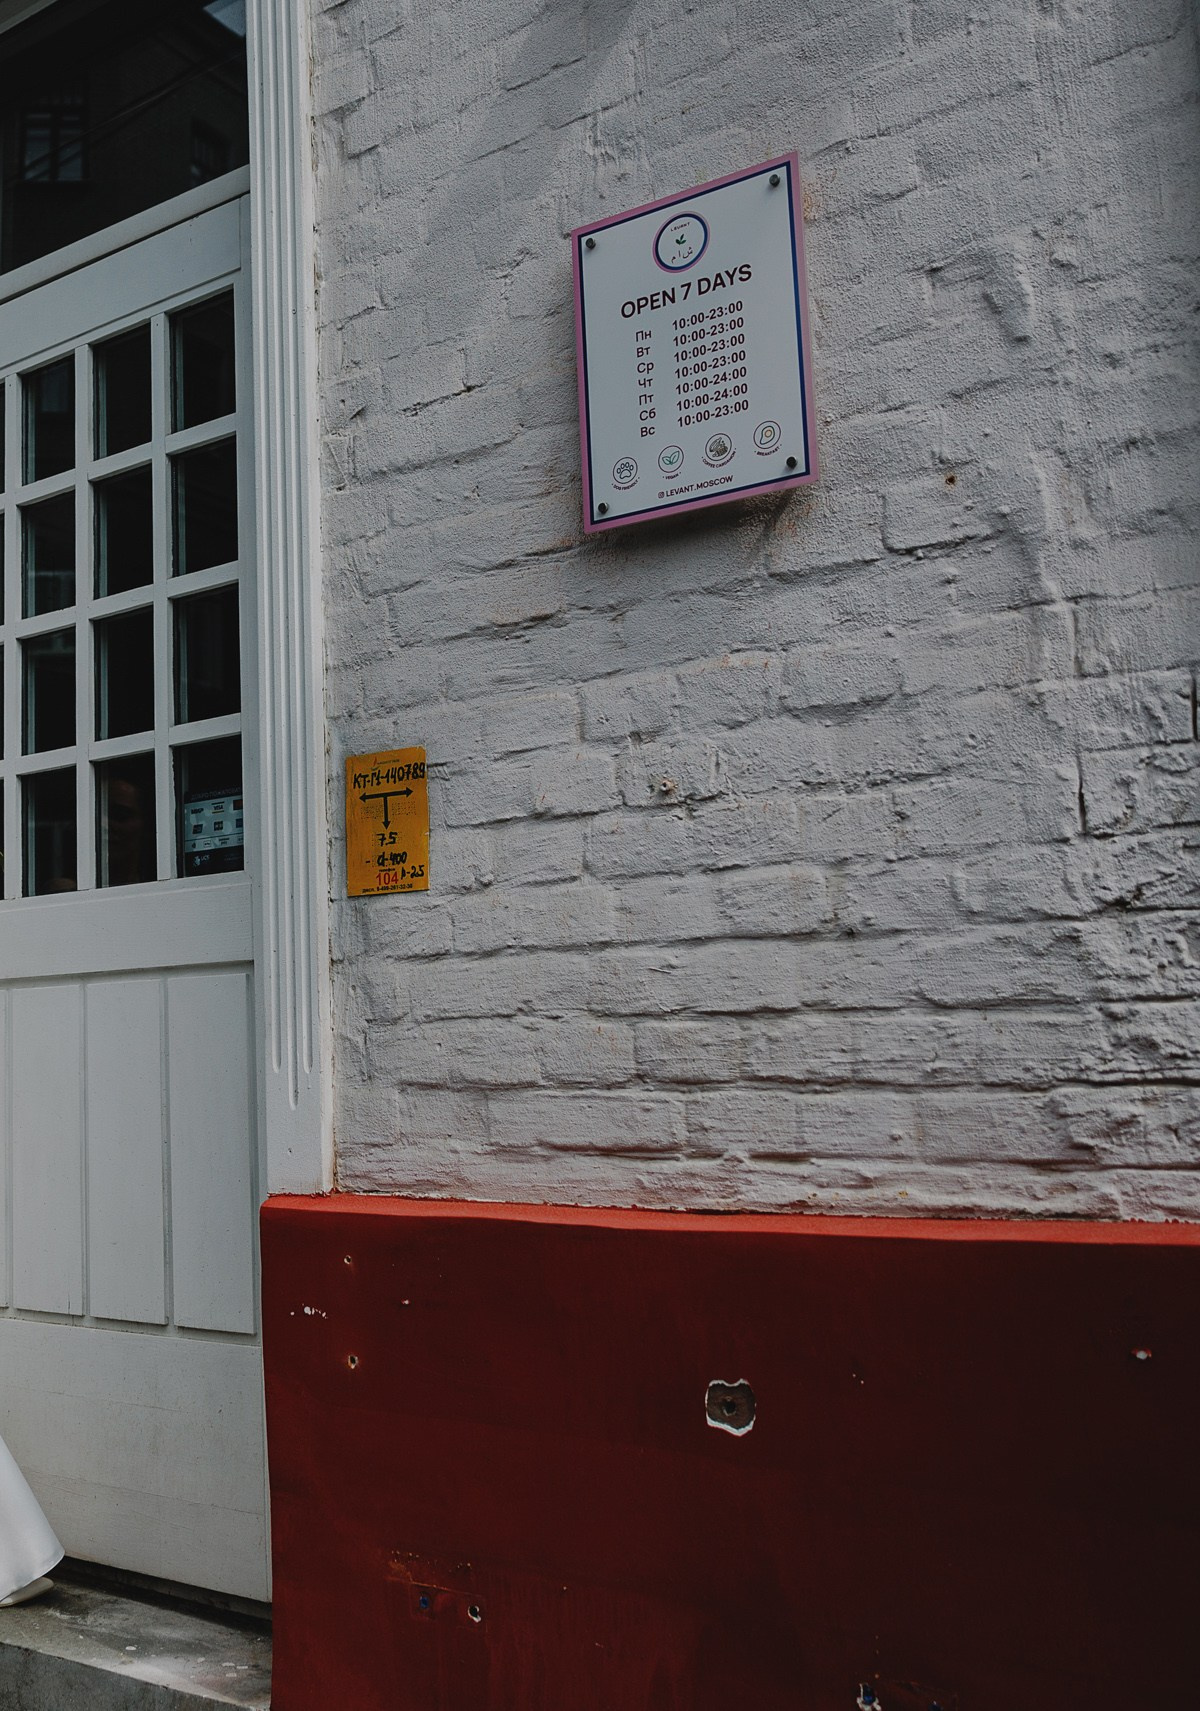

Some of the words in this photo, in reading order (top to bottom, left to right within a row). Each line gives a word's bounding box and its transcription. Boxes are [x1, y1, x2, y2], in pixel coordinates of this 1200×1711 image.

[621, 287, 676, 318] OPEN
[680, 282, 692, 301] 7
[697, 263, 752, 296] DAYS
[635, 330, 652, 342] Пн
[672, 300, 743, 331] 10:00-23:00
[636, 346, 651, 358] Вт
[673, 317, 744, 347] 10:00-23:00
[637, 362, 654, 374] Ср
[674, 333, 745, 363] 10:00-23:00
[638, 378, 653, 388] Чт
[674, 350, 746, 379] 10:00-23:00
[639, 394, 654, 406] Пт
[675, 366, 747, 395] 10:00-24:00
[639, 407, 656, 421] Сб
[676, 383, 748, 411] 10:00-24:00
[640, 426, 656, 437] Вс
[677, 399, 749, 427] 10:00-23:00
[376, 871, 399, 886] 104
